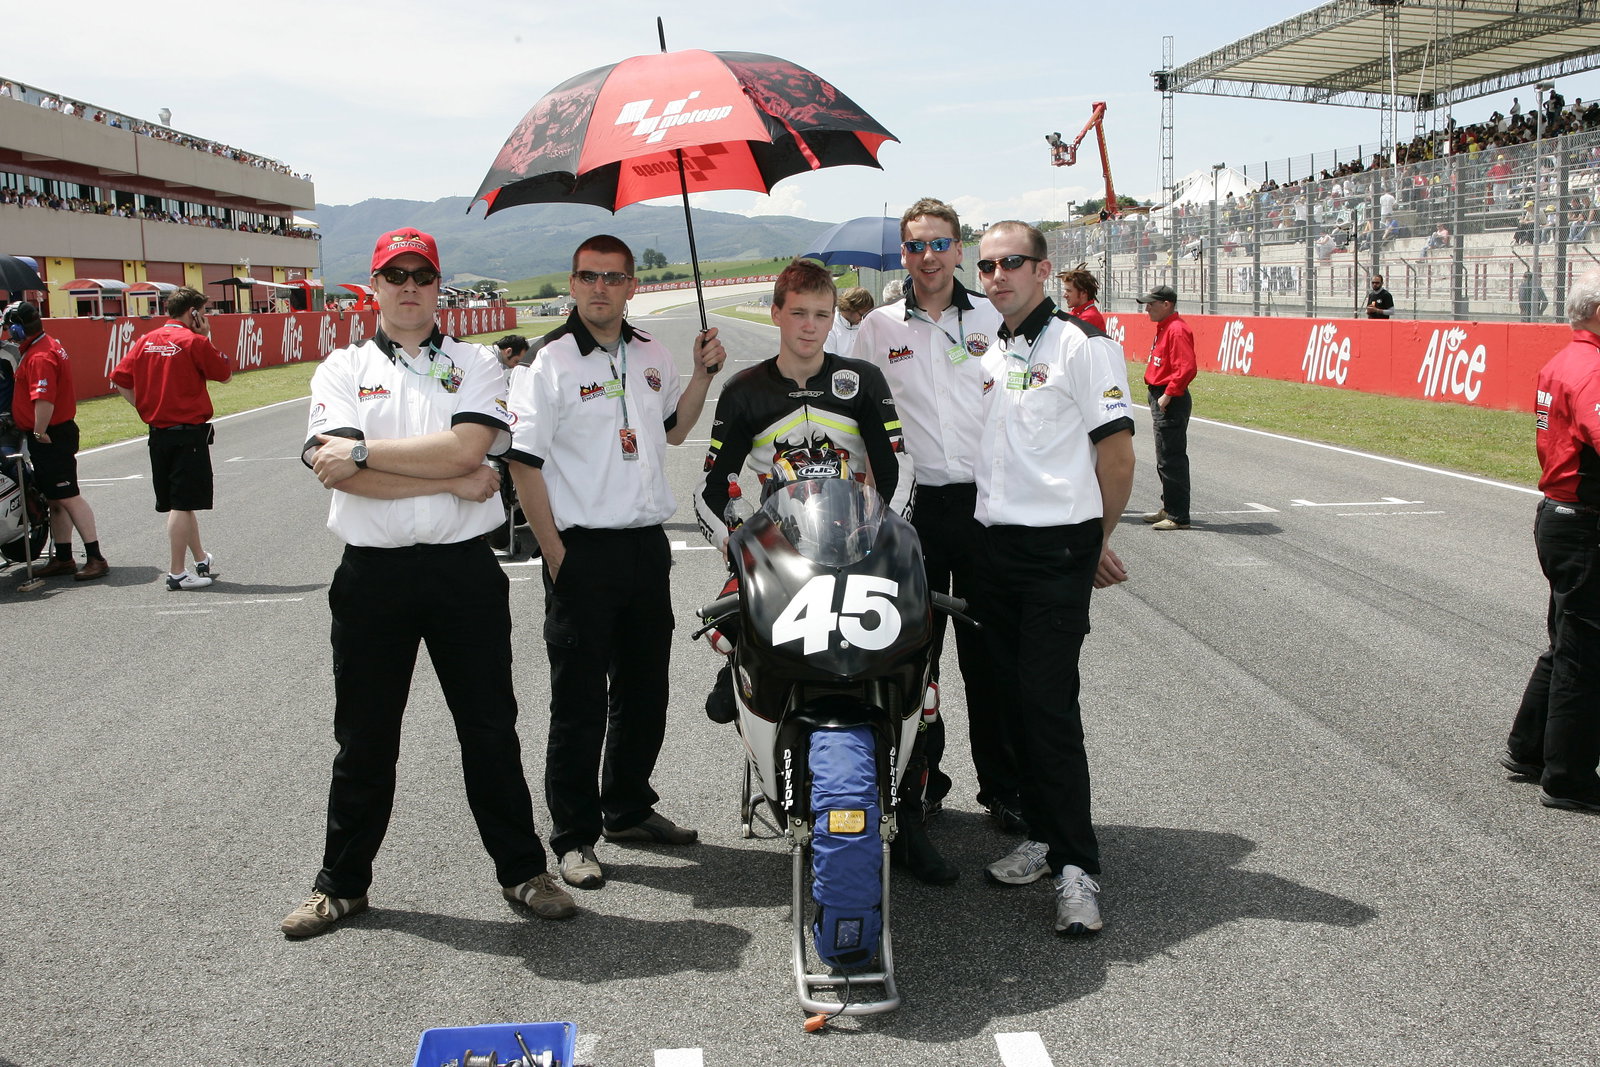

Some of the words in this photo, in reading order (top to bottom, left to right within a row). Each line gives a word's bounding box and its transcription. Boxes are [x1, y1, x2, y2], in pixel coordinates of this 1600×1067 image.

[659, 105, 733, 129] motogp
[236, 317, 262, 369] Alice
[281, 315, 303, 362] Alice
[318, 314, 337, 356] Alice
[1217, 320, 1254, 373] Alice
[1302, 322, 1350, 384] Alice
[1417, 326, 1486, 401] Alice
[772, 574, 901, 655] 45
[783, 748, 793, 810] DUNLOP
[889, 746, 898, 806] DUNLOP
